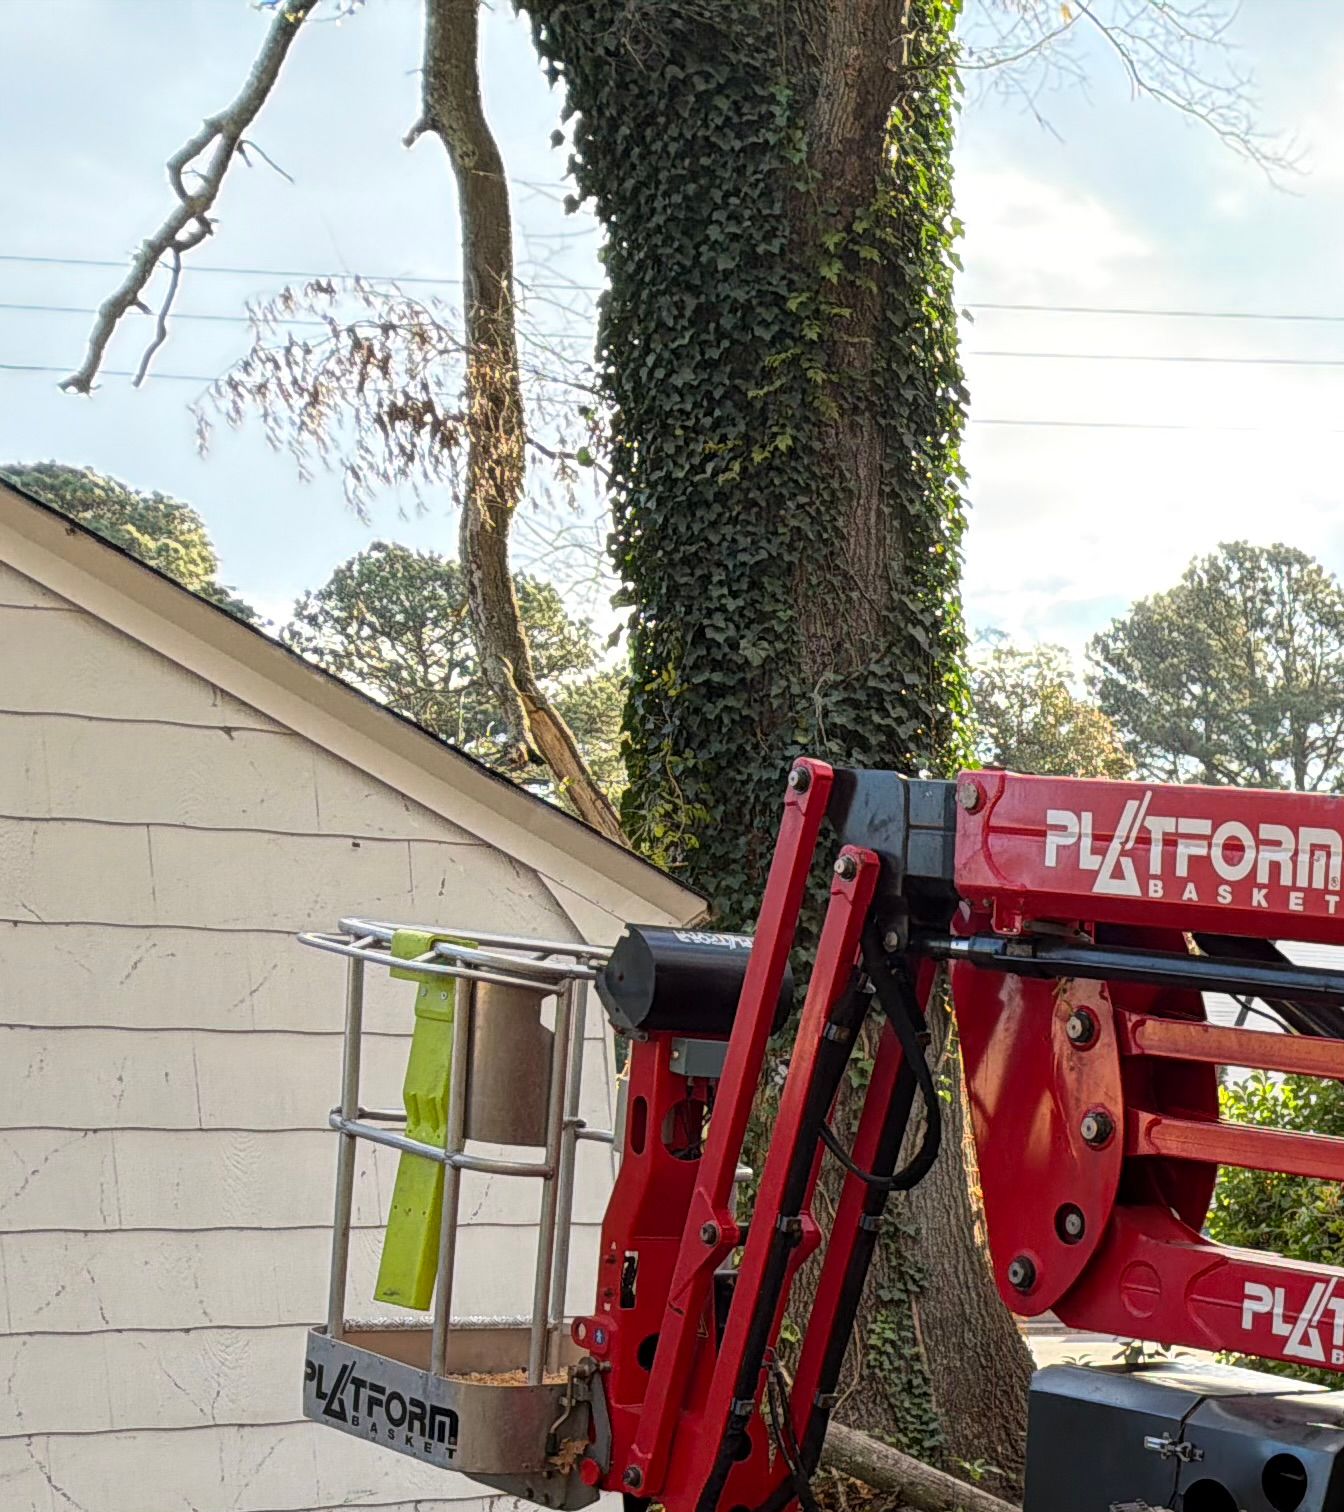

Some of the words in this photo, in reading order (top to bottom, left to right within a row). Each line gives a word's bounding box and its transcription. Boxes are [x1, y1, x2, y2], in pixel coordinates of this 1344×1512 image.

[1044, 790, 1343, 896] PLATFORM
[1148, 879, 1341, 915] BASKET
[305, 1360, 459, 1446] PLATFORM
[352, 1416, 457, 1459] BASKET
